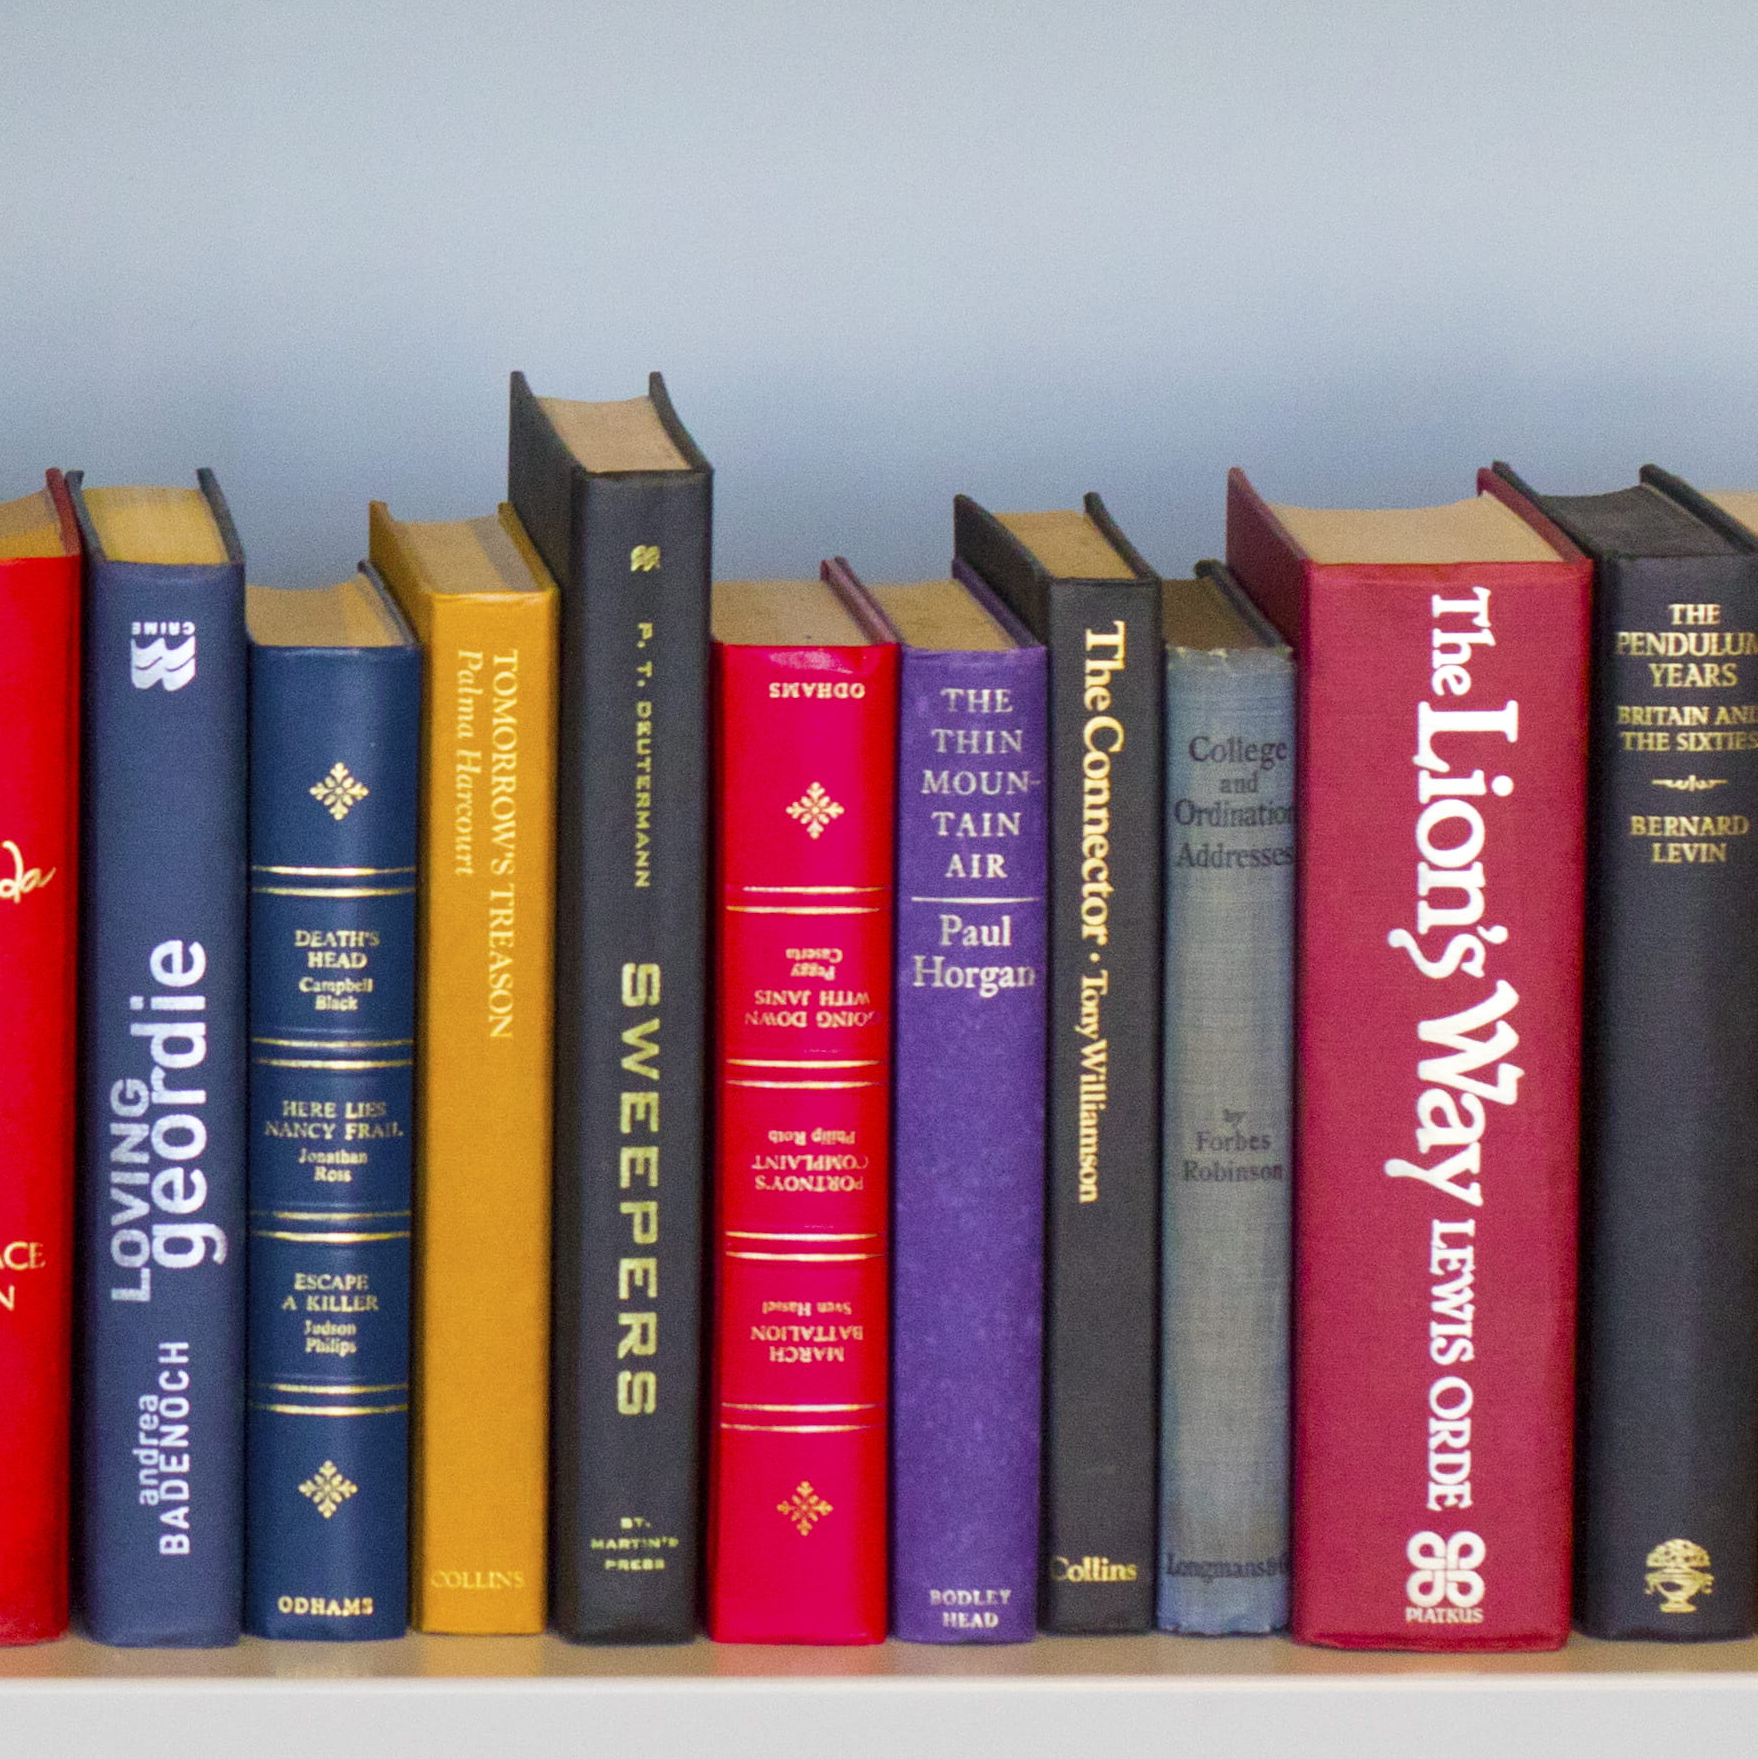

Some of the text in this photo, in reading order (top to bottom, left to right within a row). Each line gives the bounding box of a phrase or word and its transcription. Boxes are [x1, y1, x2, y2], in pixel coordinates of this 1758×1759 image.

[1649, 663, 1737, 687] YEARS
[769, 682, 865, 699] ODHAMS
[940, 689, 1013, 714] THE
[931, 729, 1023, 754] THIN
[1190, 736, 1287, 764] College
[1080, 621, 1125, 946] The Connector
[1631, 816, 1749, 837] BERNARD
[488, 649, 519, 1039] TOMORROW'S TREASON
[1653, 843, 1726, 862] LEVIN
[945, 855, 1007, 878] AIR
[938, 914, 1011, 946] Paul
[913, 956, 1035, 997] Horgan
[1385, 587, 1519, 1511] The Way LEWIS ORDE
[130, 940, 227, 1269] geordie
[110, 1078, 150, 1302] LOVING
[616, 962, 661, 1415] SWEEPERS
[305, 1296, 378, 1312] KILLER
[751, 1326, 863, 1341] BATTALION
[769, 1347, 844, 1362] MARCH
[133, 1395, 159, 1505] andrea
[159, 1342, 190, 1554] BADENOCH
[279, 1597, 372, 1614] ODHAMS
